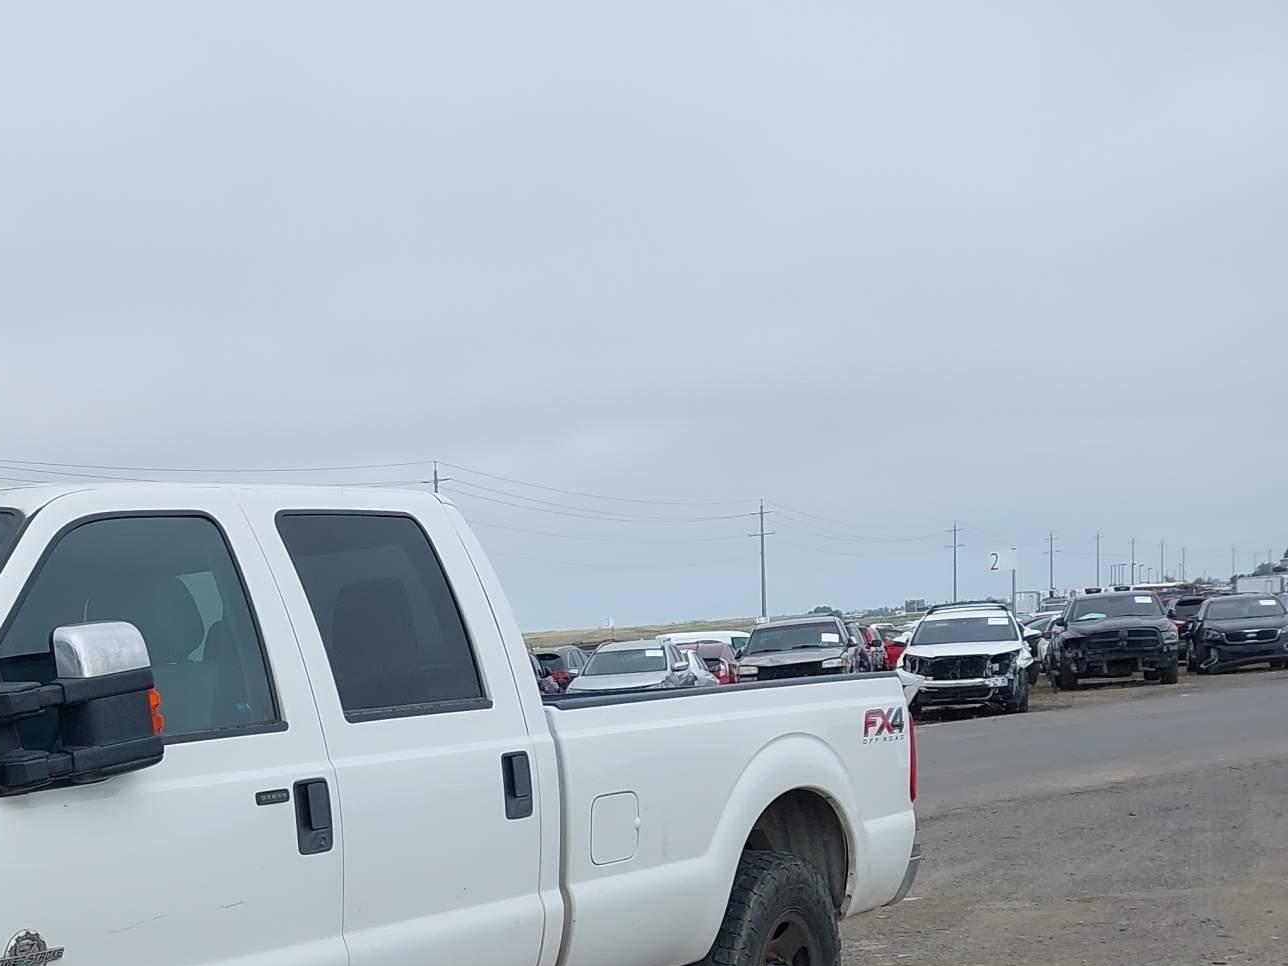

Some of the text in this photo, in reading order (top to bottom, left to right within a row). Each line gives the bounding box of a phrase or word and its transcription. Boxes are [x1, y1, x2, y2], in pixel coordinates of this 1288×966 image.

[990, 552, 999, 571] 2
[863, 706, 905, 738] FX4
[862, 734, 905, 745] OFF ROAD
[28, 948, 65, 965] STROKE
